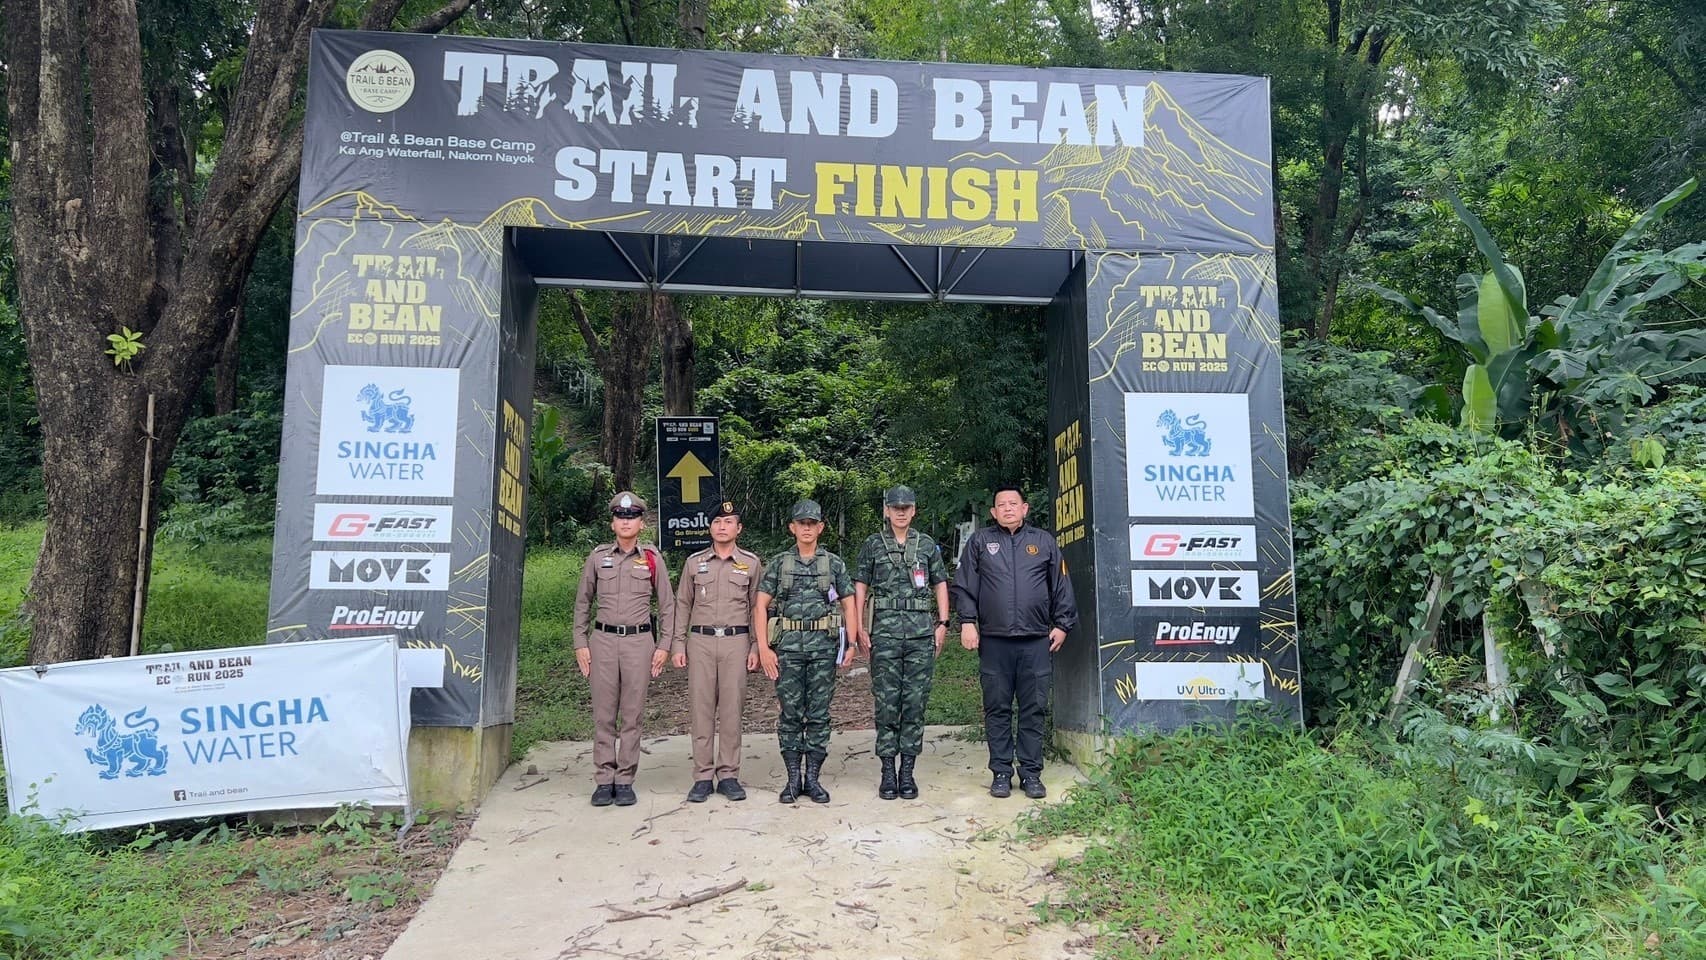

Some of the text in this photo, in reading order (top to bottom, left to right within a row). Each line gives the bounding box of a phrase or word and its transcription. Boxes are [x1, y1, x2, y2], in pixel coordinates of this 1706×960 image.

[350, 74, 411, 87] TRAIL & BEAN
[443, 51, 1146, 148] TRAIL AND BEAN
[340, 131, 536, 152] @Trail & Bean Base Camp
[339, 145, 535, 164] Ka Ang Waterfall, Nakorn Nayok
[554, 145, 1039, 222] START FINISH
[352, 254, 445, 280] TRAIL
[365, 279, 427, 304] AND
[1140, 285, 1226, 308] TRAIL
[348, 303, 442, 332] BEAN
[1154, 309, 1211, 332] AND
[380, 334, 405, 345] RUN
[409, 335, 441, 346] 2025
[1141, 332, 1227, 359] BEAN
[1173, 362, 1196, 372] RUN
[1199, 362, 1228, 372] 2025
[337, 440, 436, 460] SINGHA
[348, 462, 424, 481] WATER
[1058, 455, 1078, 497] AND
[1144, 464, 1235, 482] SINGHA
[499, 468, 523, 520] BEAN
[1156, 485, 1226, 502] WATER
[1055, 484, 1084, 532] BEAN
[328, 513, 437, 536] G-FAST
[1144, 534, 1242, 556] G-FAST
[328, 558, 431, 584] MOVE
[1149, 576, 1242, 601] MOVE
[330, 606, 425, 630] ProEngy
[1155, 621, 1241, 645] ProEngy
[189, 659, 214, 671] AND
[219, 656, 252, 669] BEAN
[187, 672, 211, 683] RUN
[215, 668, 244, 680] 2025
[1177, 684, 1226, 696] UV Ultra
[180, 696, 329, 735] SINGHA
[183, 730, 299, 765] WATER
